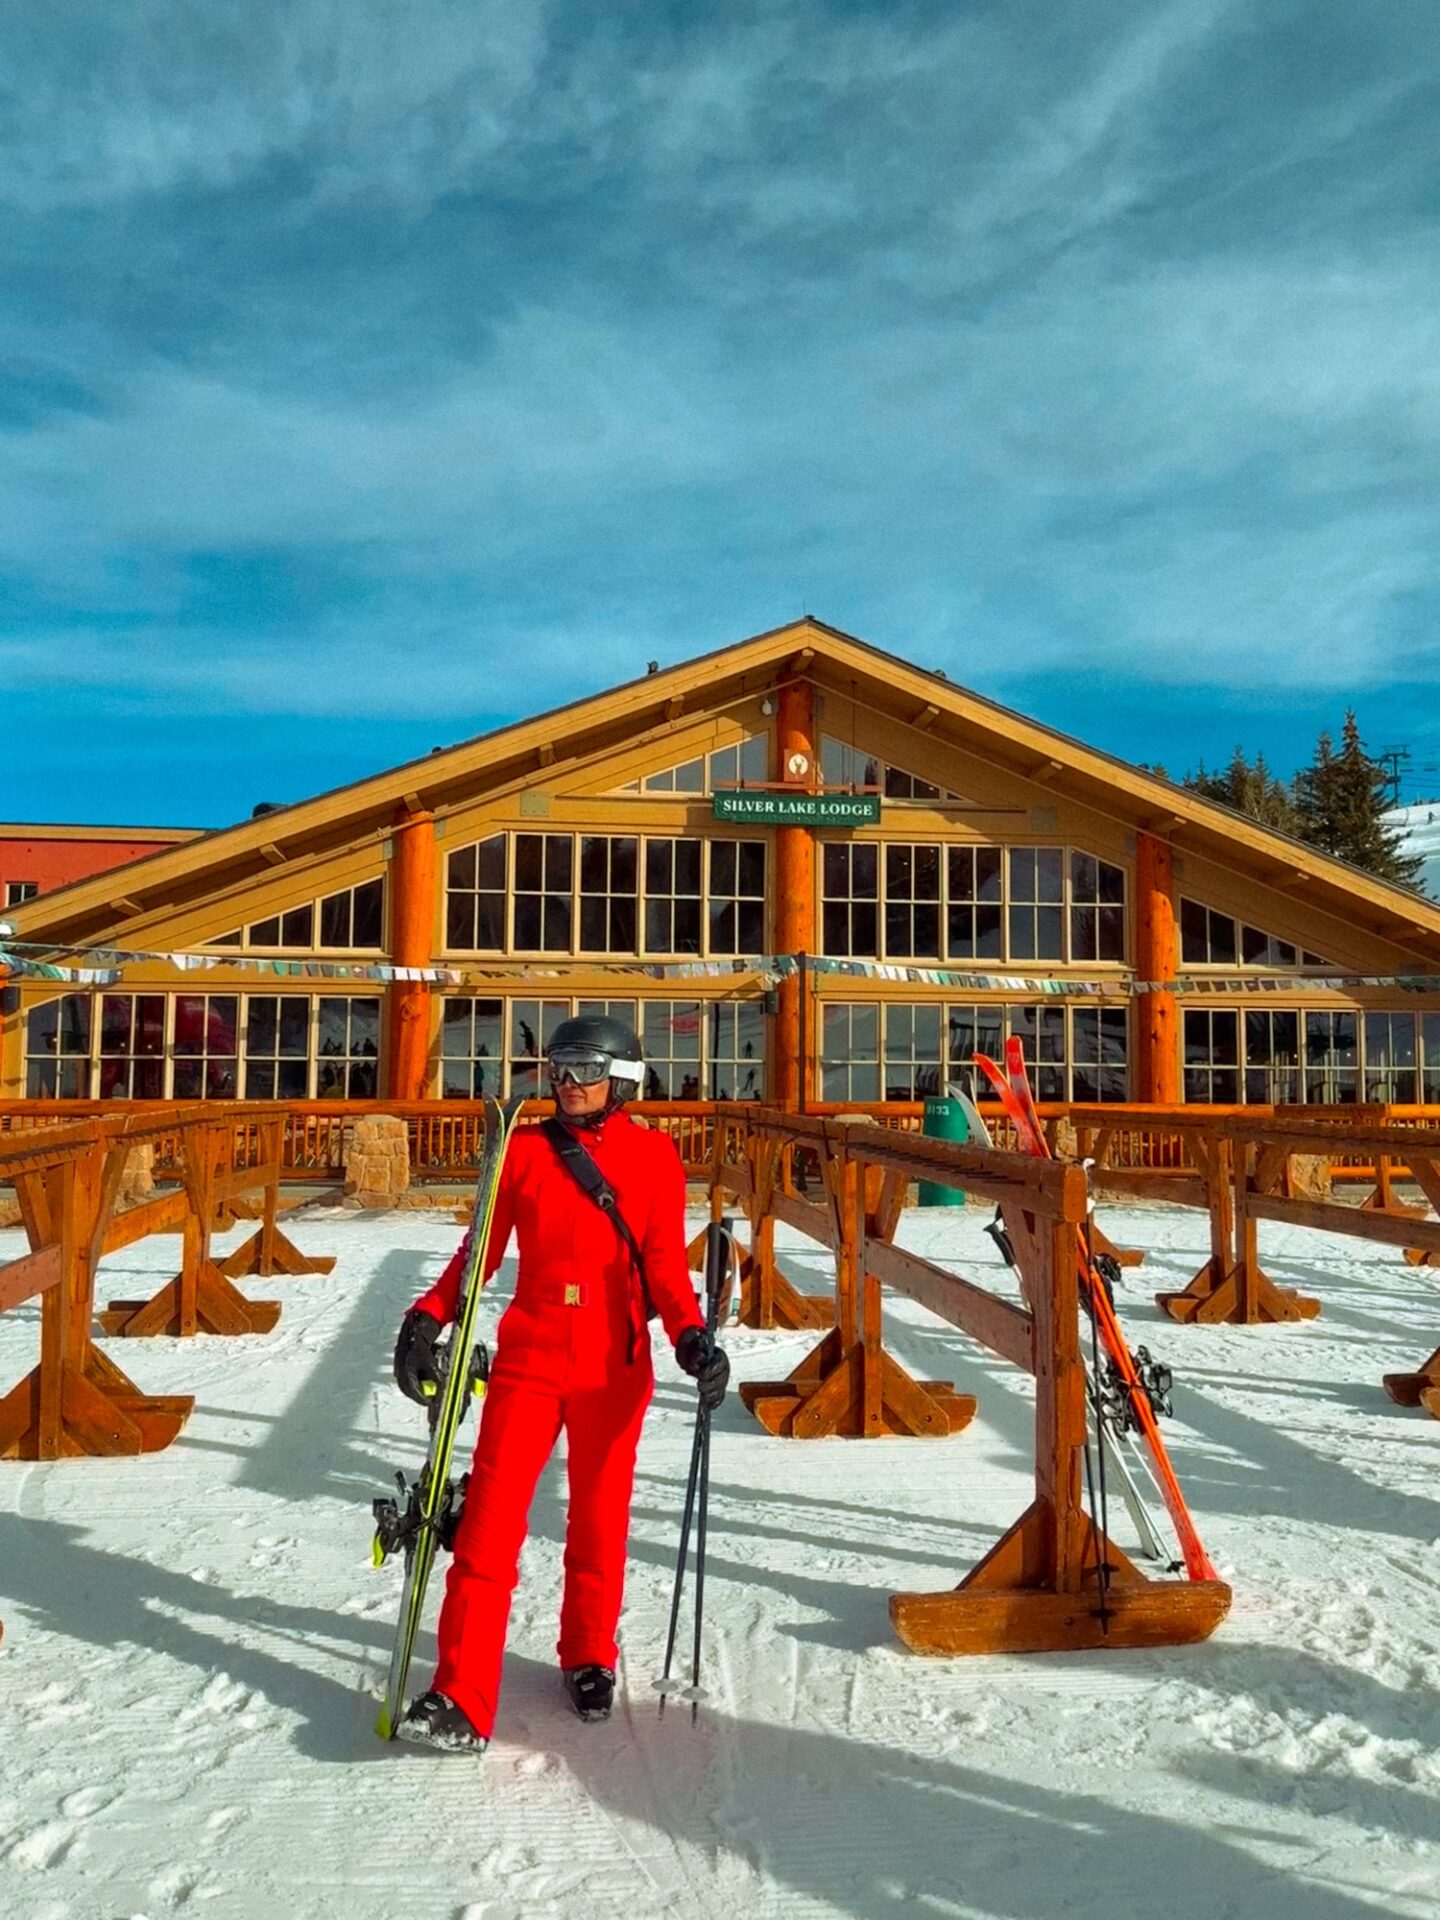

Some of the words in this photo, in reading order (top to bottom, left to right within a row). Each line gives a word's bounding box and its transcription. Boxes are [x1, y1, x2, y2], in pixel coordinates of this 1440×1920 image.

[723, 799, 775, 813] SILVER
[778, 802, 816, 814] LAKE
[820, 803, 873, 816] LODGE
